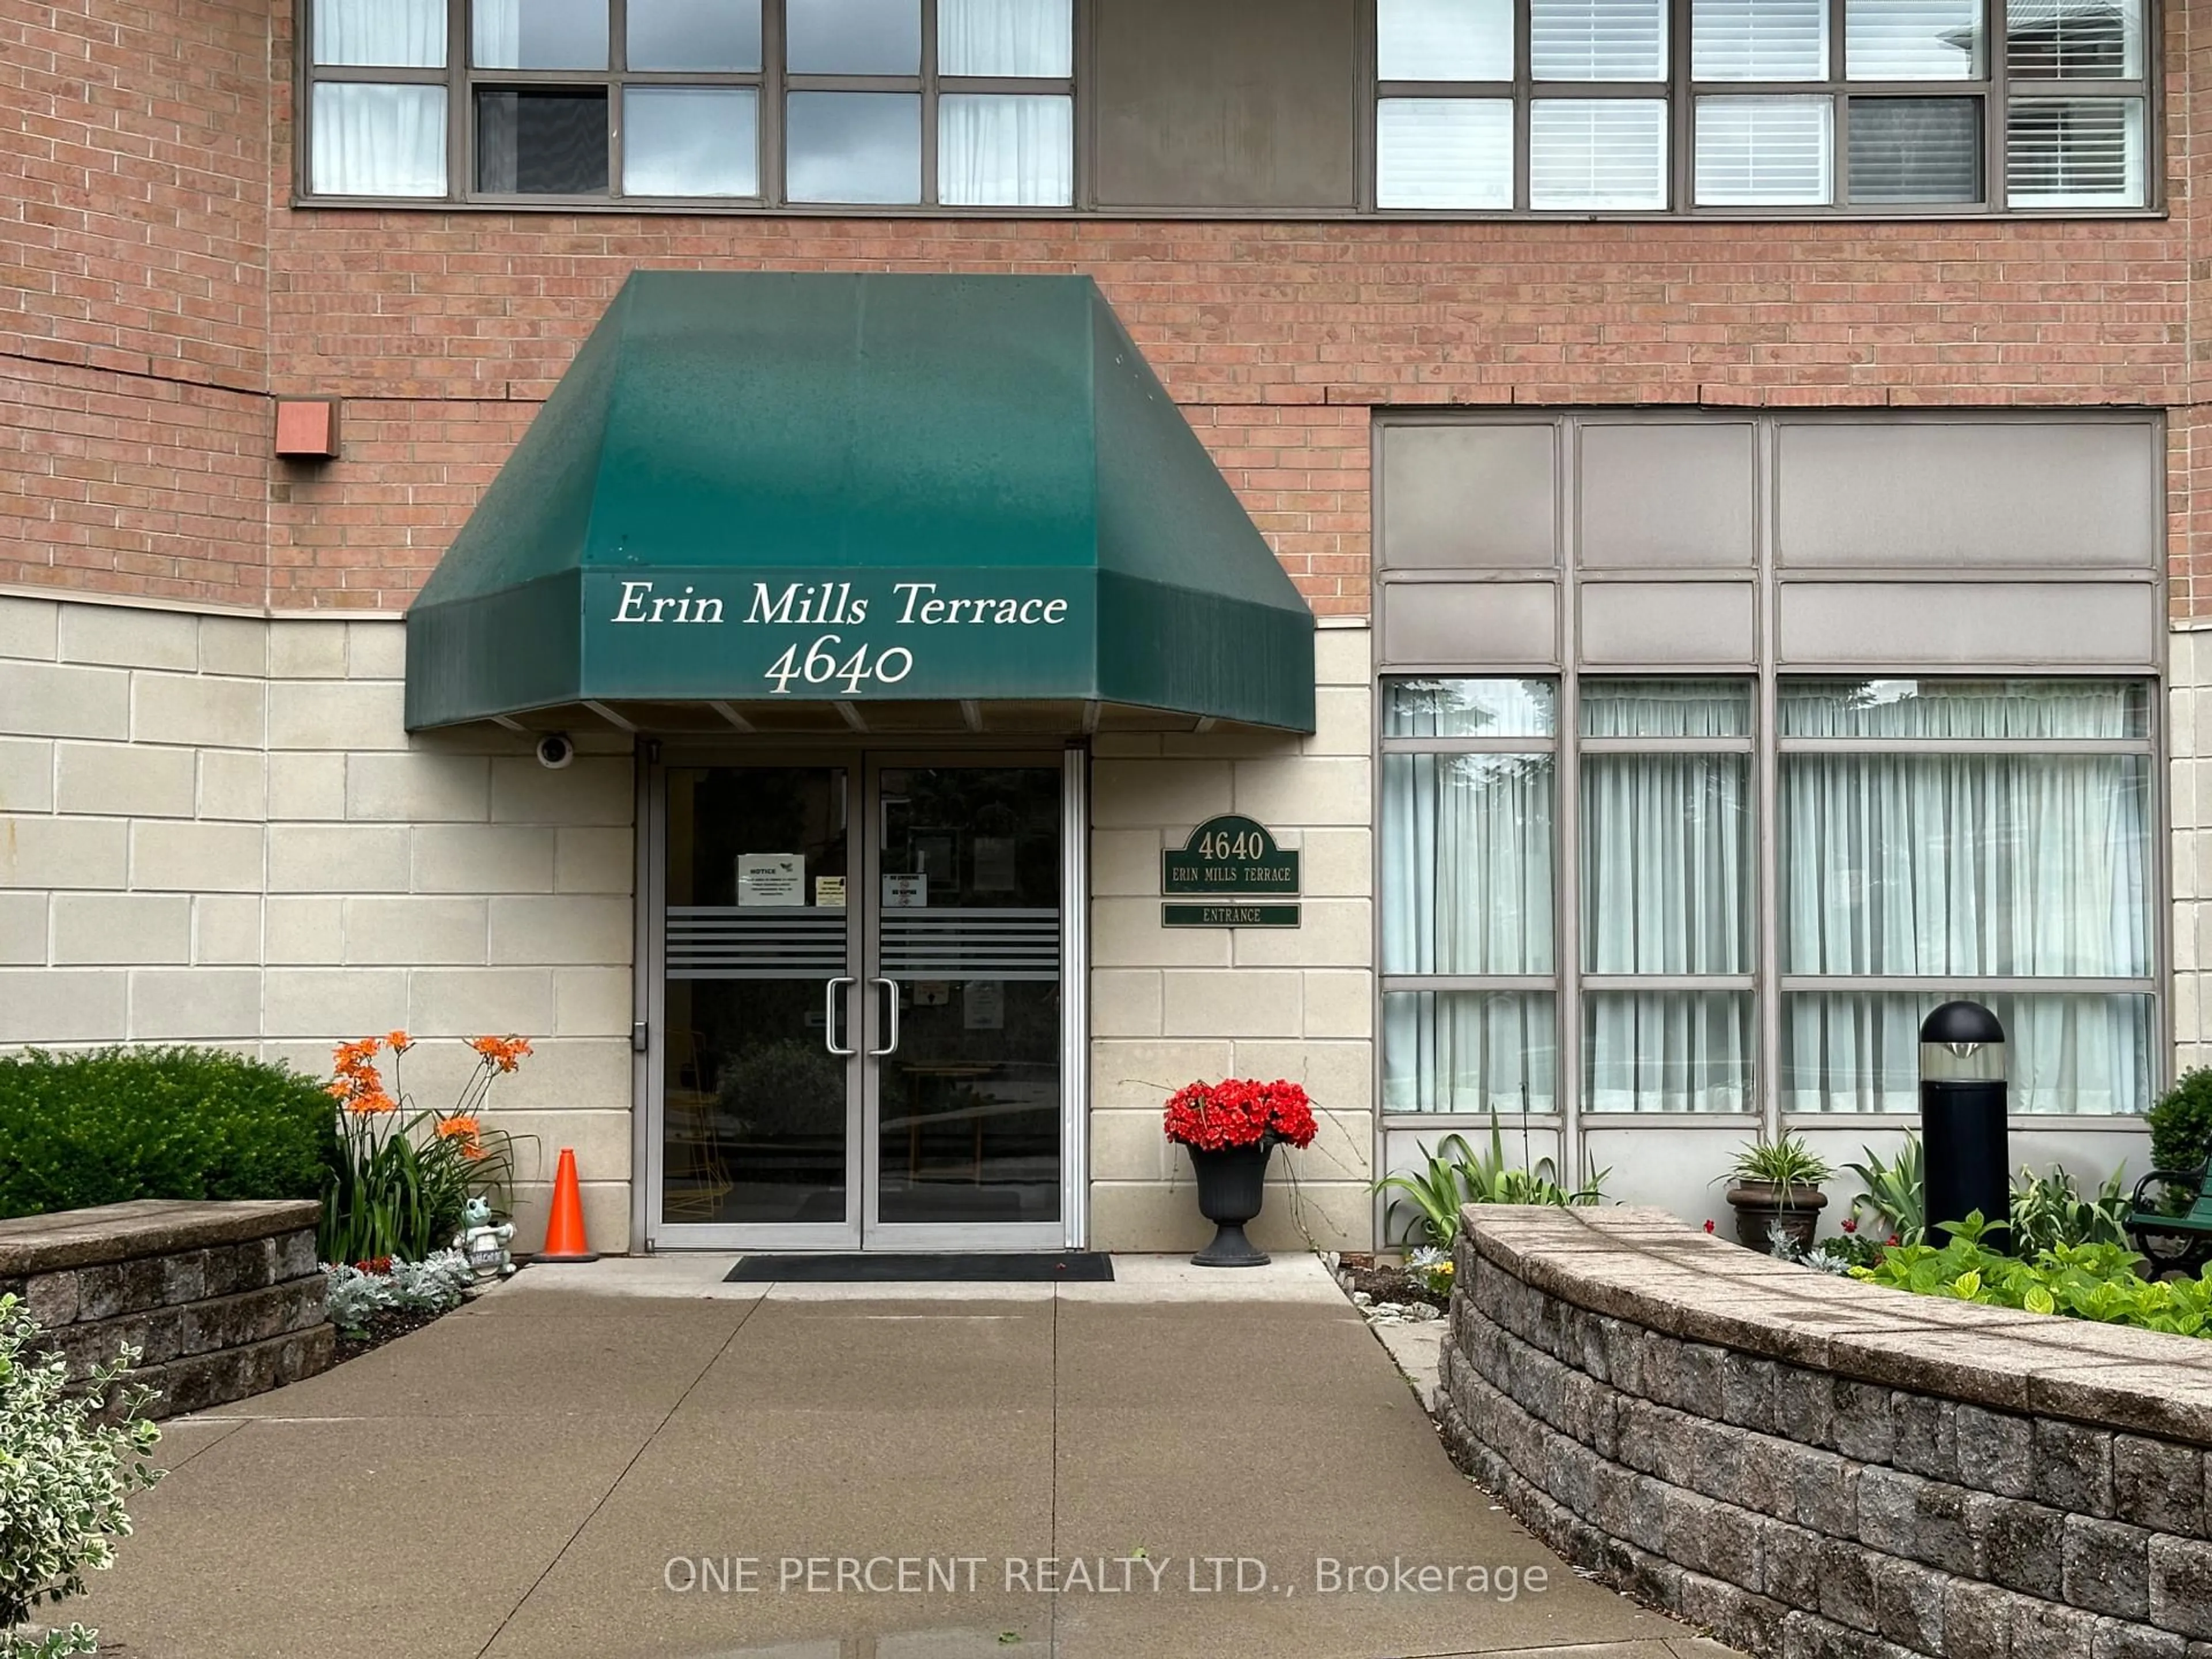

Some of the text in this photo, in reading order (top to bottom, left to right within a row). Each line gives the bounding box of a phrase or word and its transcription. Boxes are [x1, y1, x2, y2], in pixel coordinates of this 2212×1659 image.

[611, 581, 1069, 625] Erin Mills Terrace
[764, 634, 914, 694] 4640
[1198, 831, 1264, 860] 4640
[1172, 868, 1291, 881] ERIN MILLS TERRACE
[1203, 908, 1261, 922] ENTRANCE
